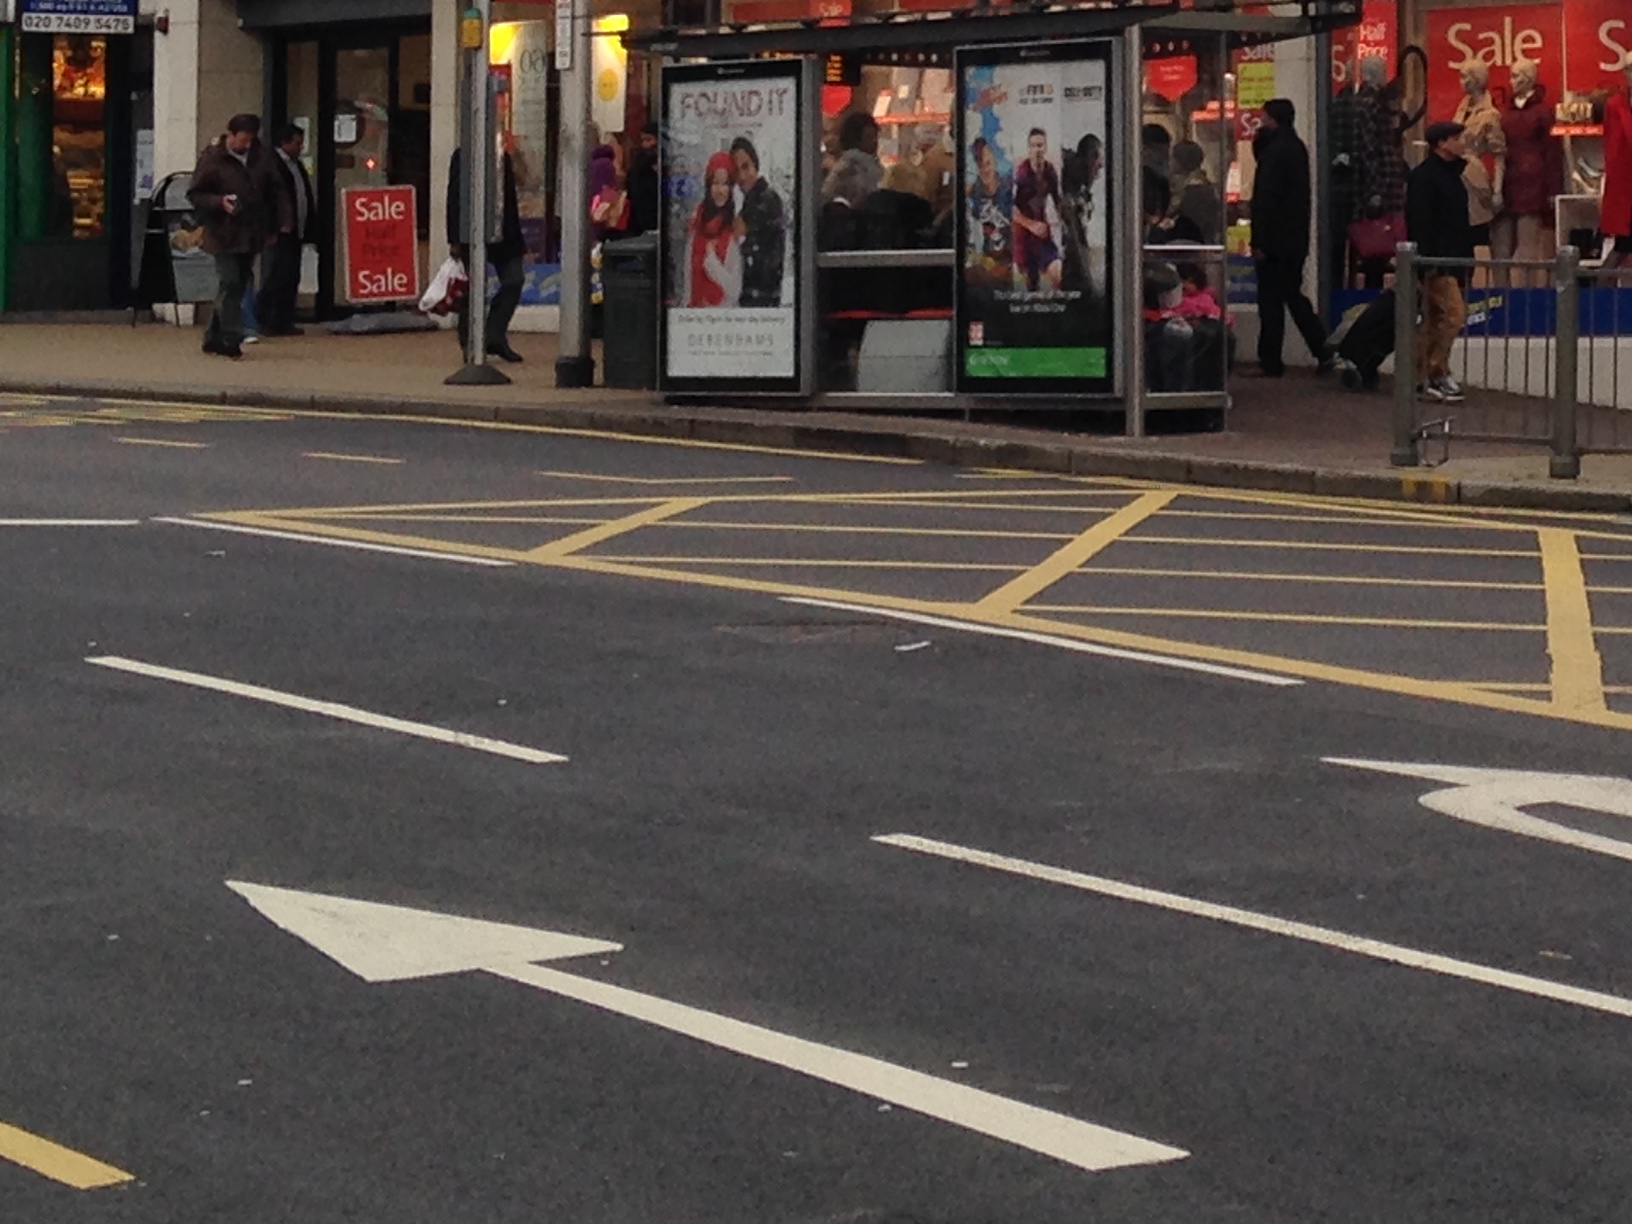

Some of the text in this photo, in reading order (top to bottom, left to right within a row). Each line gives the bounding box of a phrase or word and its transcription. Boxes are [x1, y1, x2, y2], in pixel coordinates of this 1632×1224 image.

[1447, 15, 1544, 71] Sale
[354, 194, 406, 222] Sale
[357, 266, 409, 294] Sale
